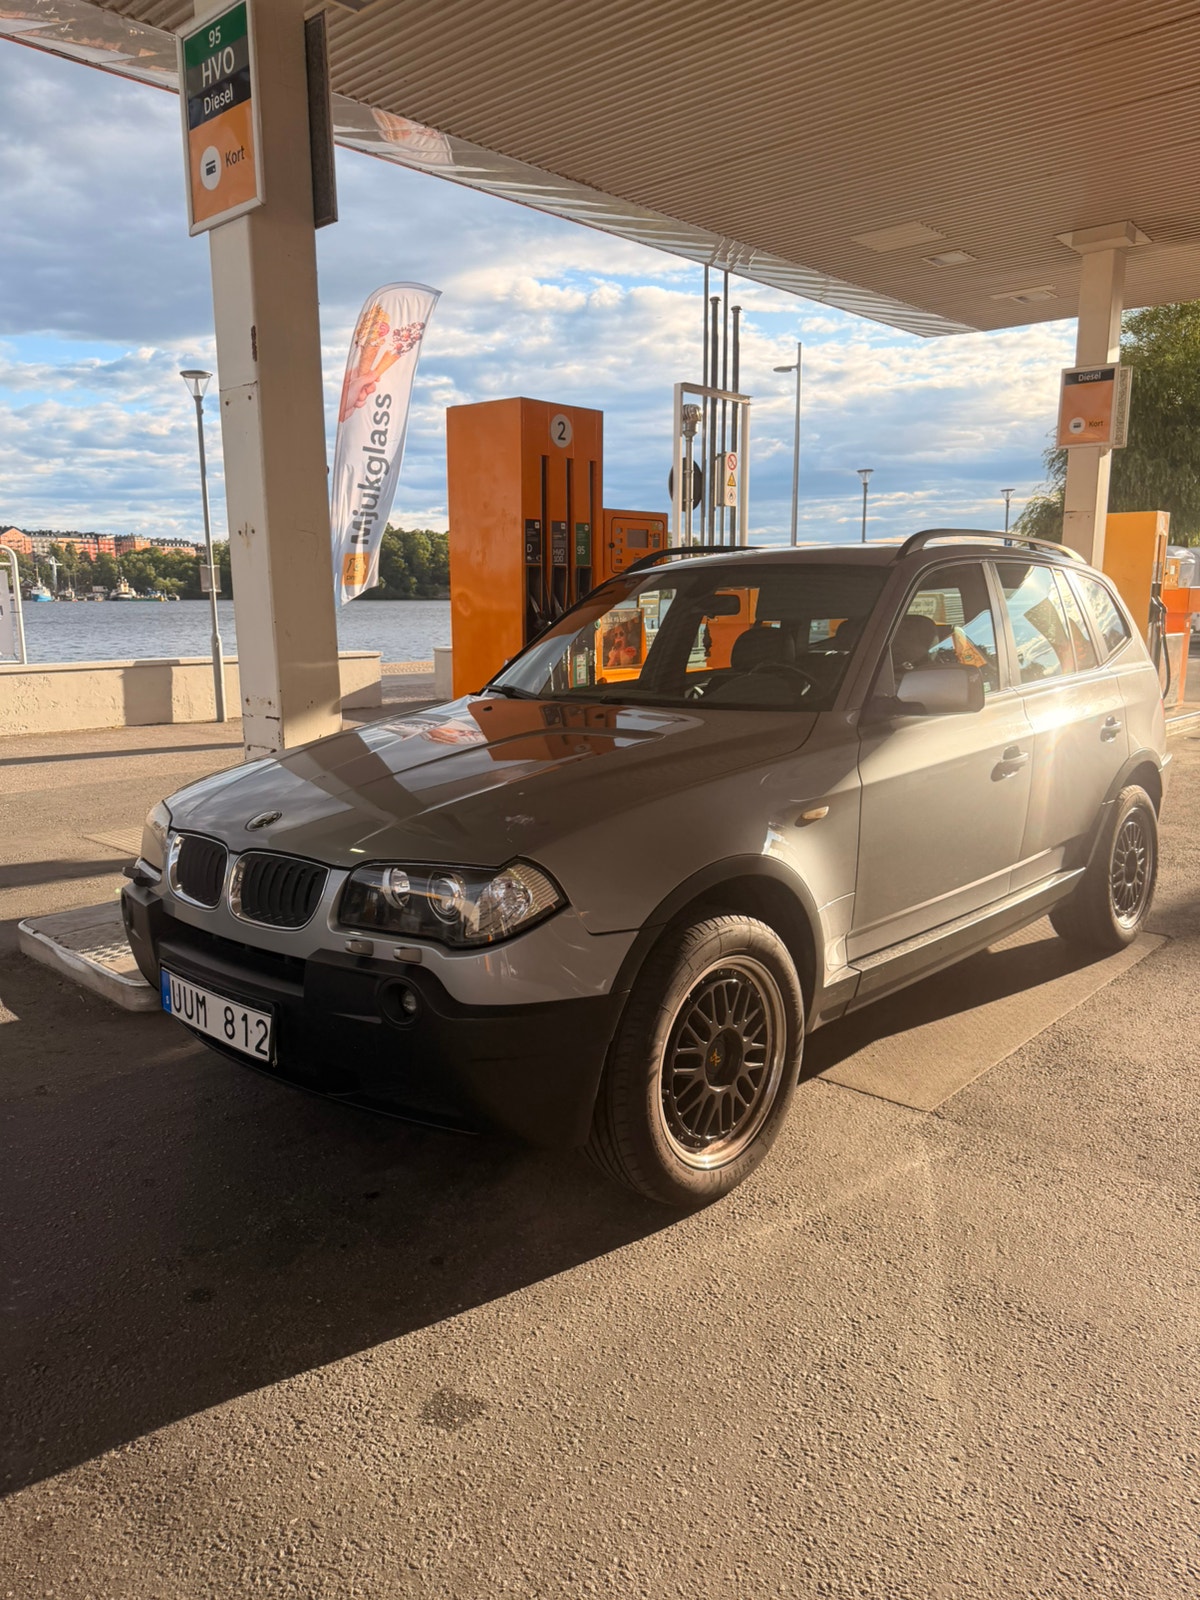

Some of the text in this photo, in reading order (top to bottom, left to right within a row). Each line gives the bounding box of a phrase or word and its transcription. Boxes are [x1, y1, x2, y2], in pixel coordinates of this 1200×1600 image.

[208, 26, 221, 47] 95
[202, 46, 235, 87] HVO
[203, 83, 233, 115] Diesel
[225, 145, 245, 168] Kort
[1078, 371, 1101, 382] Diesel
[557, 421, 566, 441] 2
[1088, 420, 1104, 428] Kort
[351, 393, 392, 545] Mjukglass
[526, 543, 533, 553] D
[576, 545, 586, 555] 95
[172, 979, 268, 1056] UUM 812
